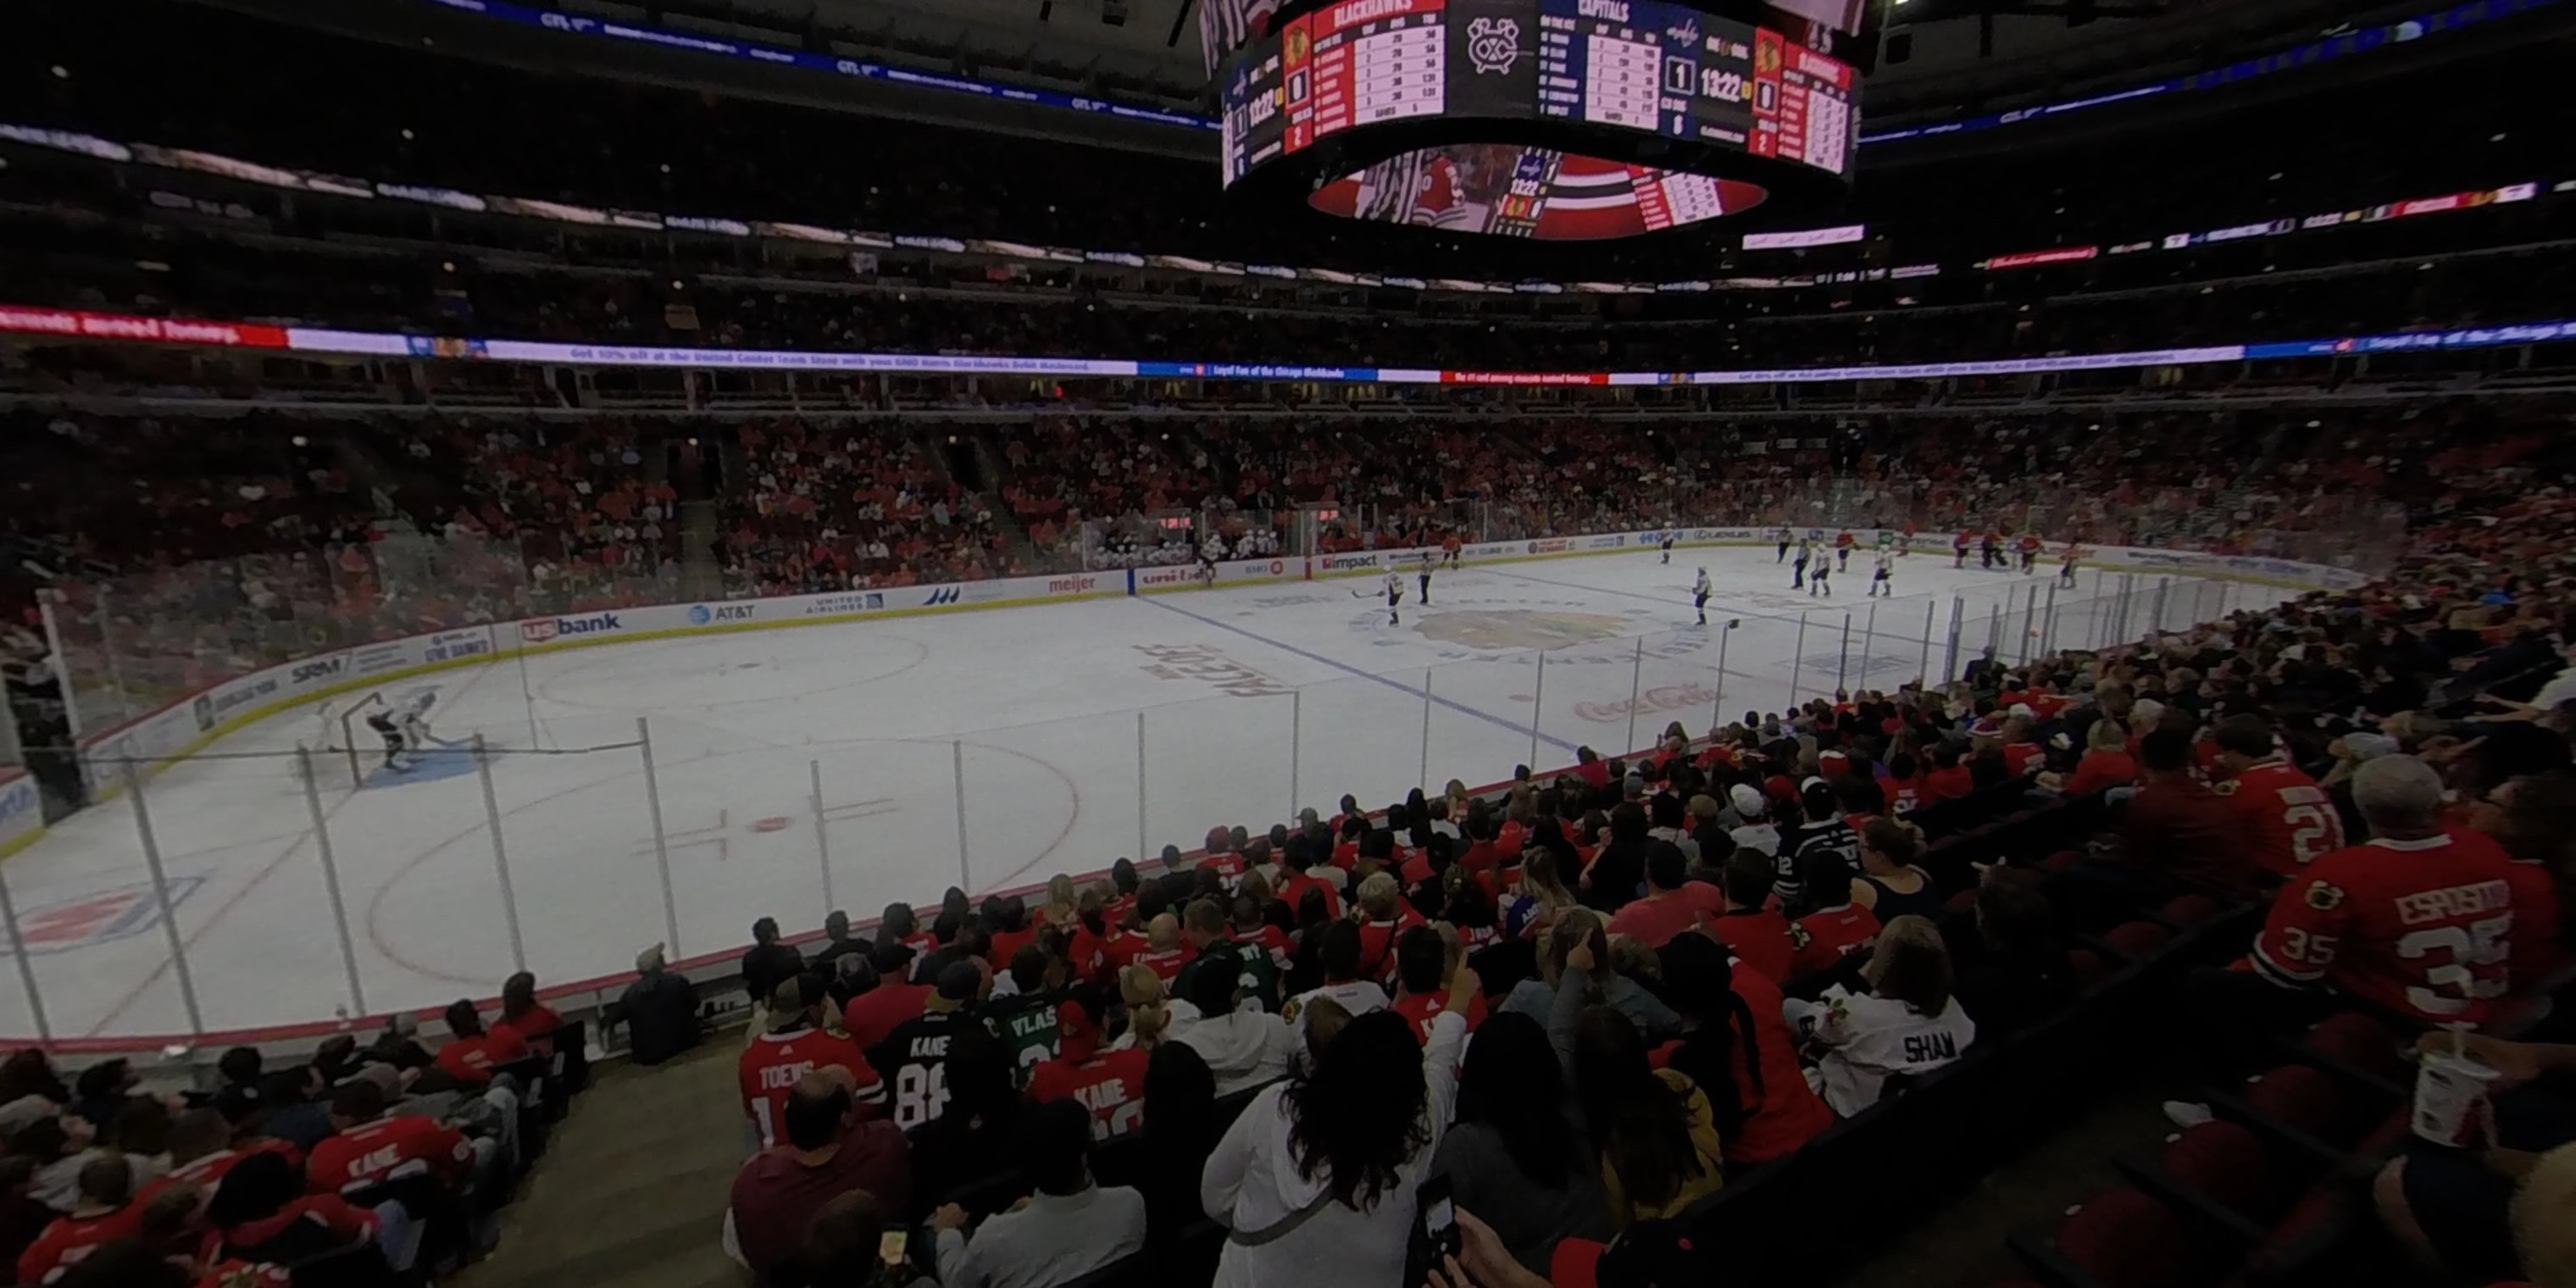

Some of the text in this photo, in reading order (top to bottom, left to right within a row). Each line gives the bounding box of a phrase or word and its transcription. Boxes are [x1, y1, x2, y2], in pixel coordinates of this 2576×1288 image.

[1334, 0, 1413, 27] BLACKHAWKS
[1578, 0, 1629, 23] CAPITALS
[1676, 64, 1685, 89] 1
[1701, 68, 1740, 103] 13:22
[1758, 134, 1767, 153] 2
[1274, 366, 1302, 378] Chicago
[1707, 530, 1752, 539] LEXUS
[1332, 554, 1378, 569] impact
[1048, 575, 1096, 593] meijer
[715, 604, 754, 621] AT&T
[2394, 879, 2511, 925] ESPOSITO
[2281, 926, 2339, 965] 35
[2396, 911, 2515, 1015] 35
[1011, 1005, 1058, 1038] VLAS
[909, 1035, 951, 1058] KANE
[1904, 1030, 1956, 1063] SHAW
[1074, 1077, 1129, 1111] KANE
